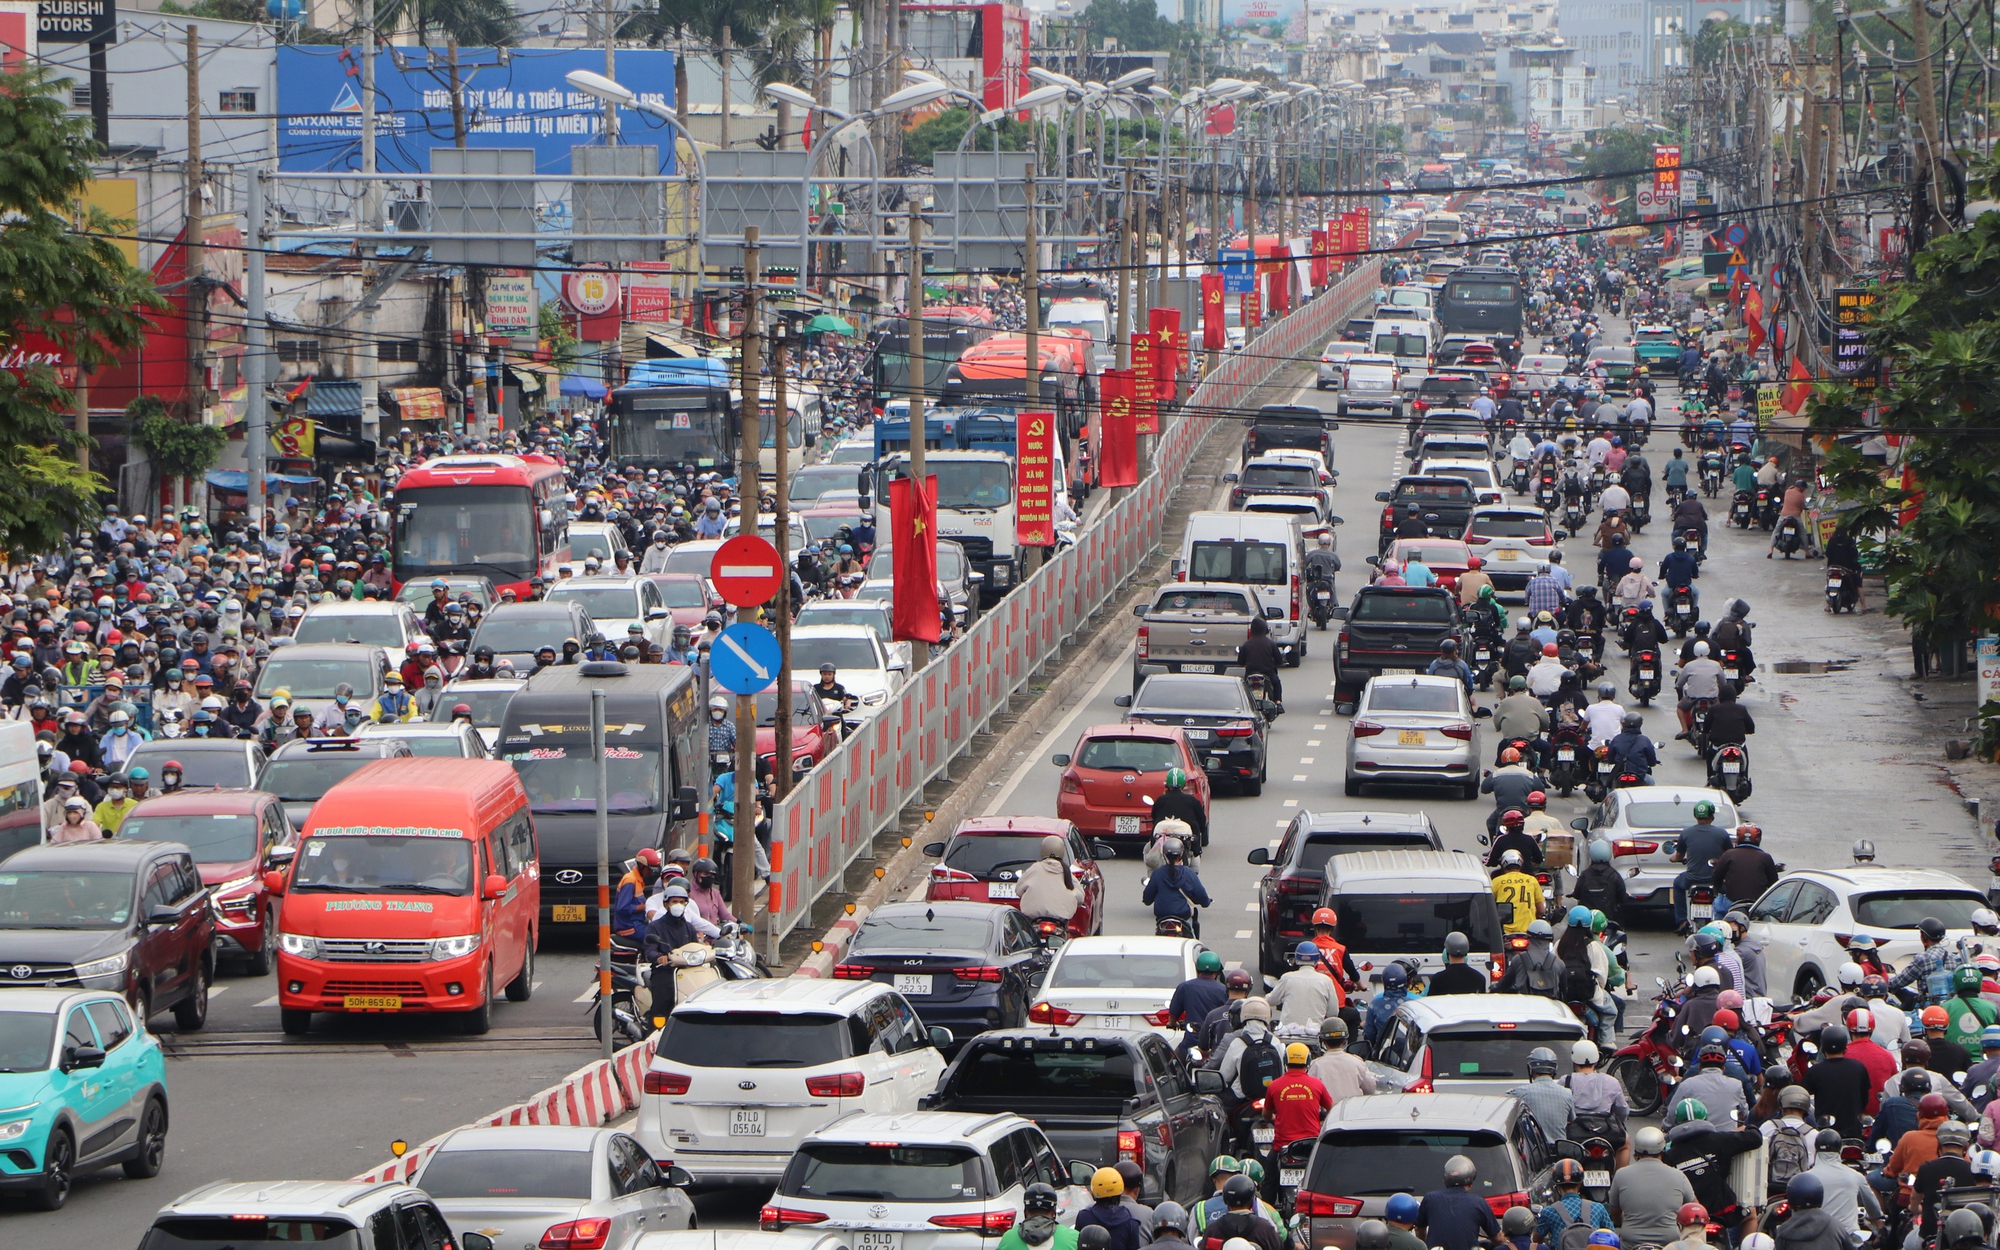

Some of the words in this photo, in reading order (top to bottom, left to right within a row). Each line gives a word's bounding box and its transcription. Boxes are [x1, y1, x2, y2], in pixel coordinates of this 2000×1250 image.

[37, 17, 93, 32] OTORS
[583, 280, 604, 299] 15
[1840, 296, 1858, 306] MUA
[674, 414, 688, 429] 19
[1021, 455, 1036, 466] CỘNG
[1020, 483, 1032, 493] CHỦ
[1022, 498, 1034, 508] VIỆT
[1035, 499, 1046, 507] NAM
[369, 826, 392, 835] CÔNG
[419, 827, 437, 835] VIÊN
[1503, 885, 1531, 909] 24
[387, 902, 433, 912] TRANG
[898, 985, 927, 993] 252.32
[349, 998, 397, 1007] 50H-869.62
[1104, 1018, 1122, 1028] 51F
[1957, 1034, 1981, 1044] Grab
[737, 1111, 759, 1122] 61LD
[733, 1124, 762, 1134] 055.04
[864, 1234, 892, 1244] 61LD
